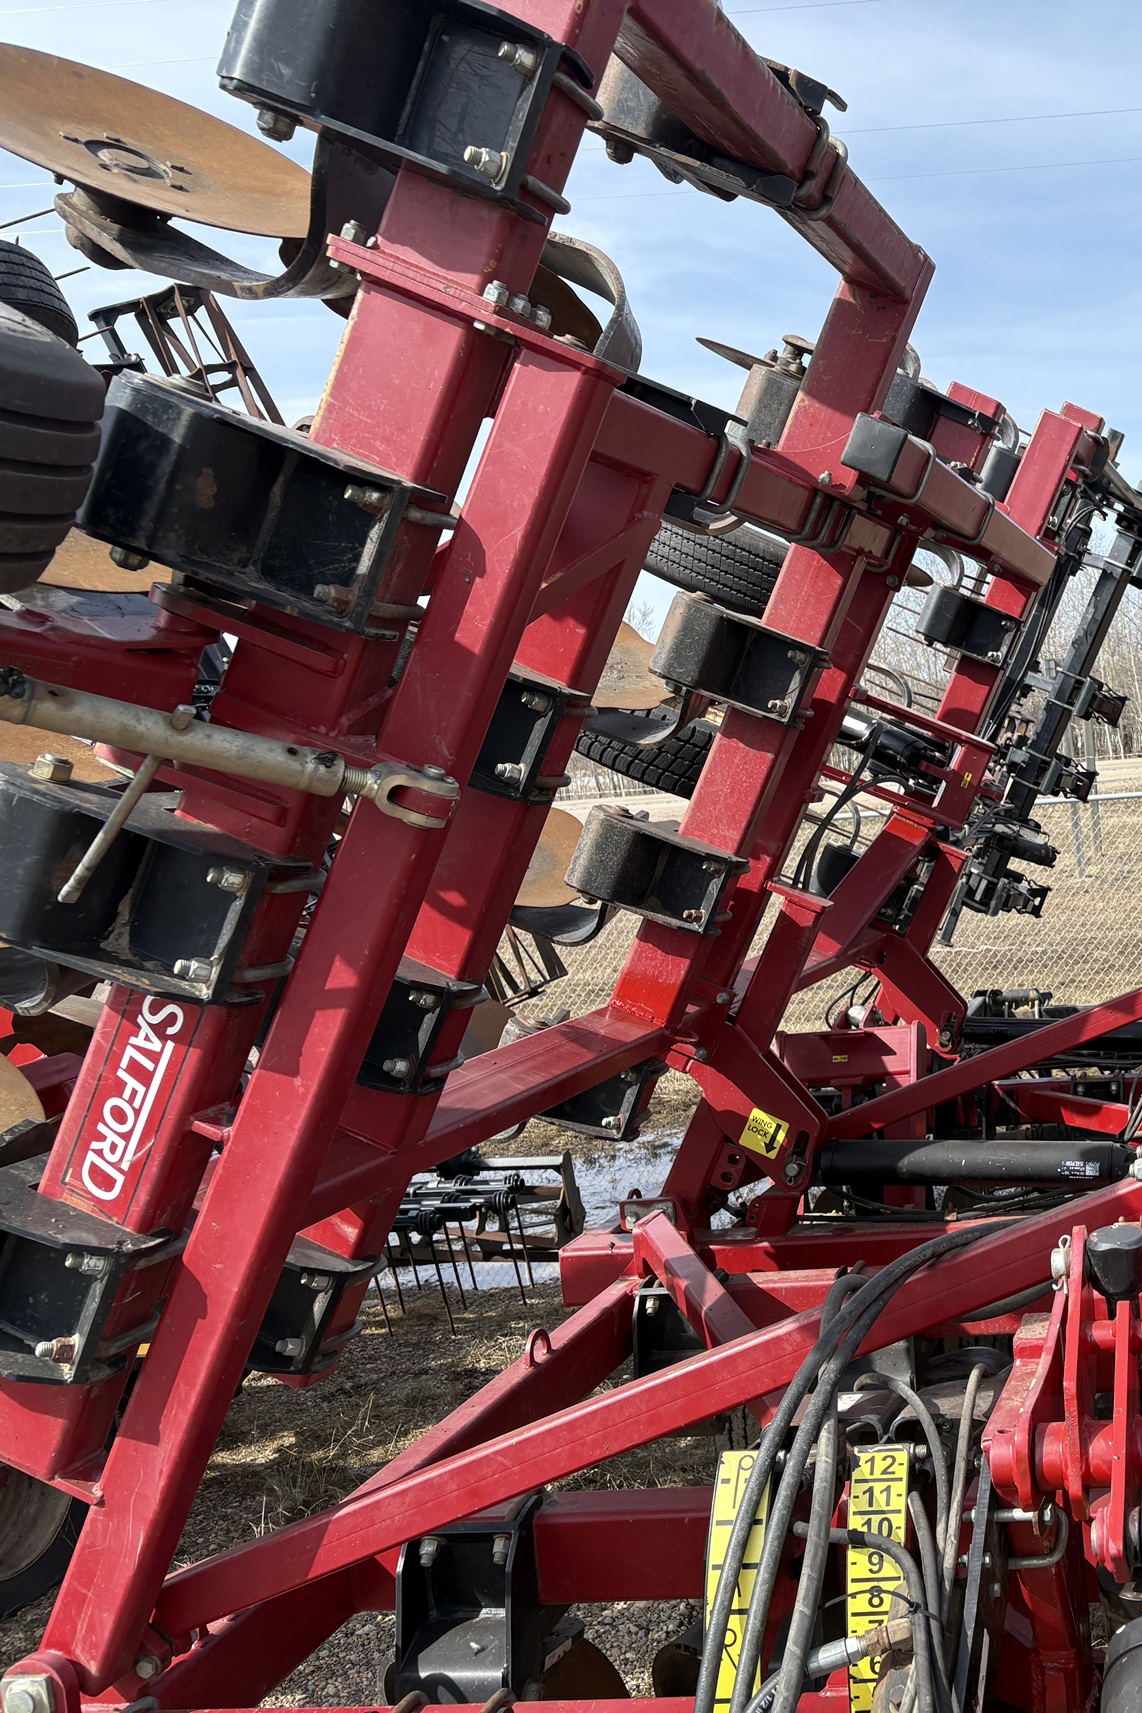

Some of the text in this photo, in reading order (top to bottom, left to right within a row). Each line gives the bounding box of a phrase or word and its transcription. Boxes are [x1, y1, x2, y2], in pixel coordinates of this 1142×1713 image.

[82, 995, 184, 1200] SALFORD
[747, 1124, 769, 1138] LOCK
[752, 1115, 773, 1129] WING
[865, 1455, 897, 1475] 12
[863, 1485, 891, 1507] 11
[861, 1517, 893, 1539] 10
[868, 1551, 884, 1574] 9
[868, 1585, 884, 1608] 8
